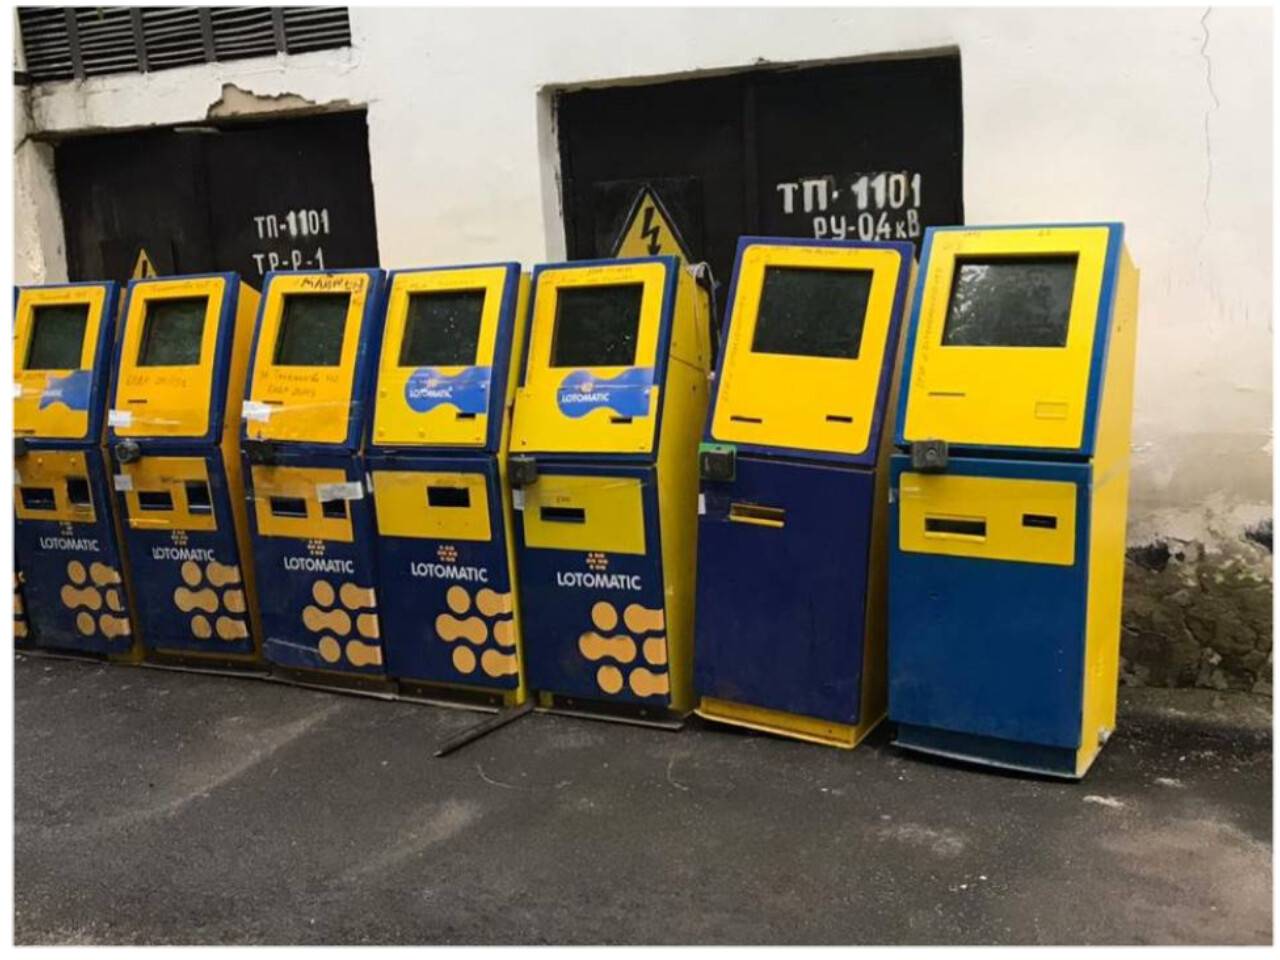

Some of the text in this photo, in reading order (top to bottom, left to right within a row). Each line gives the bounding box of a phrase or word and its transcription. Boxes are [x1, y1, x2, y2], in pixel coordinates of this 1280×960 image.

[254, 208, 329, 239] ТП-1101
[561, 392, 610, 404] LOTOMATIC
[39, 537, 100, 552] LOTOMATIC
[152, 547, 215, 561] LOTOMATIC
[283, 557, 354, 574] LOTOMATIC
[410, 562, 489, 582] LOTOMATIC
[557, 572, 642, 590] LOTOMATIC
